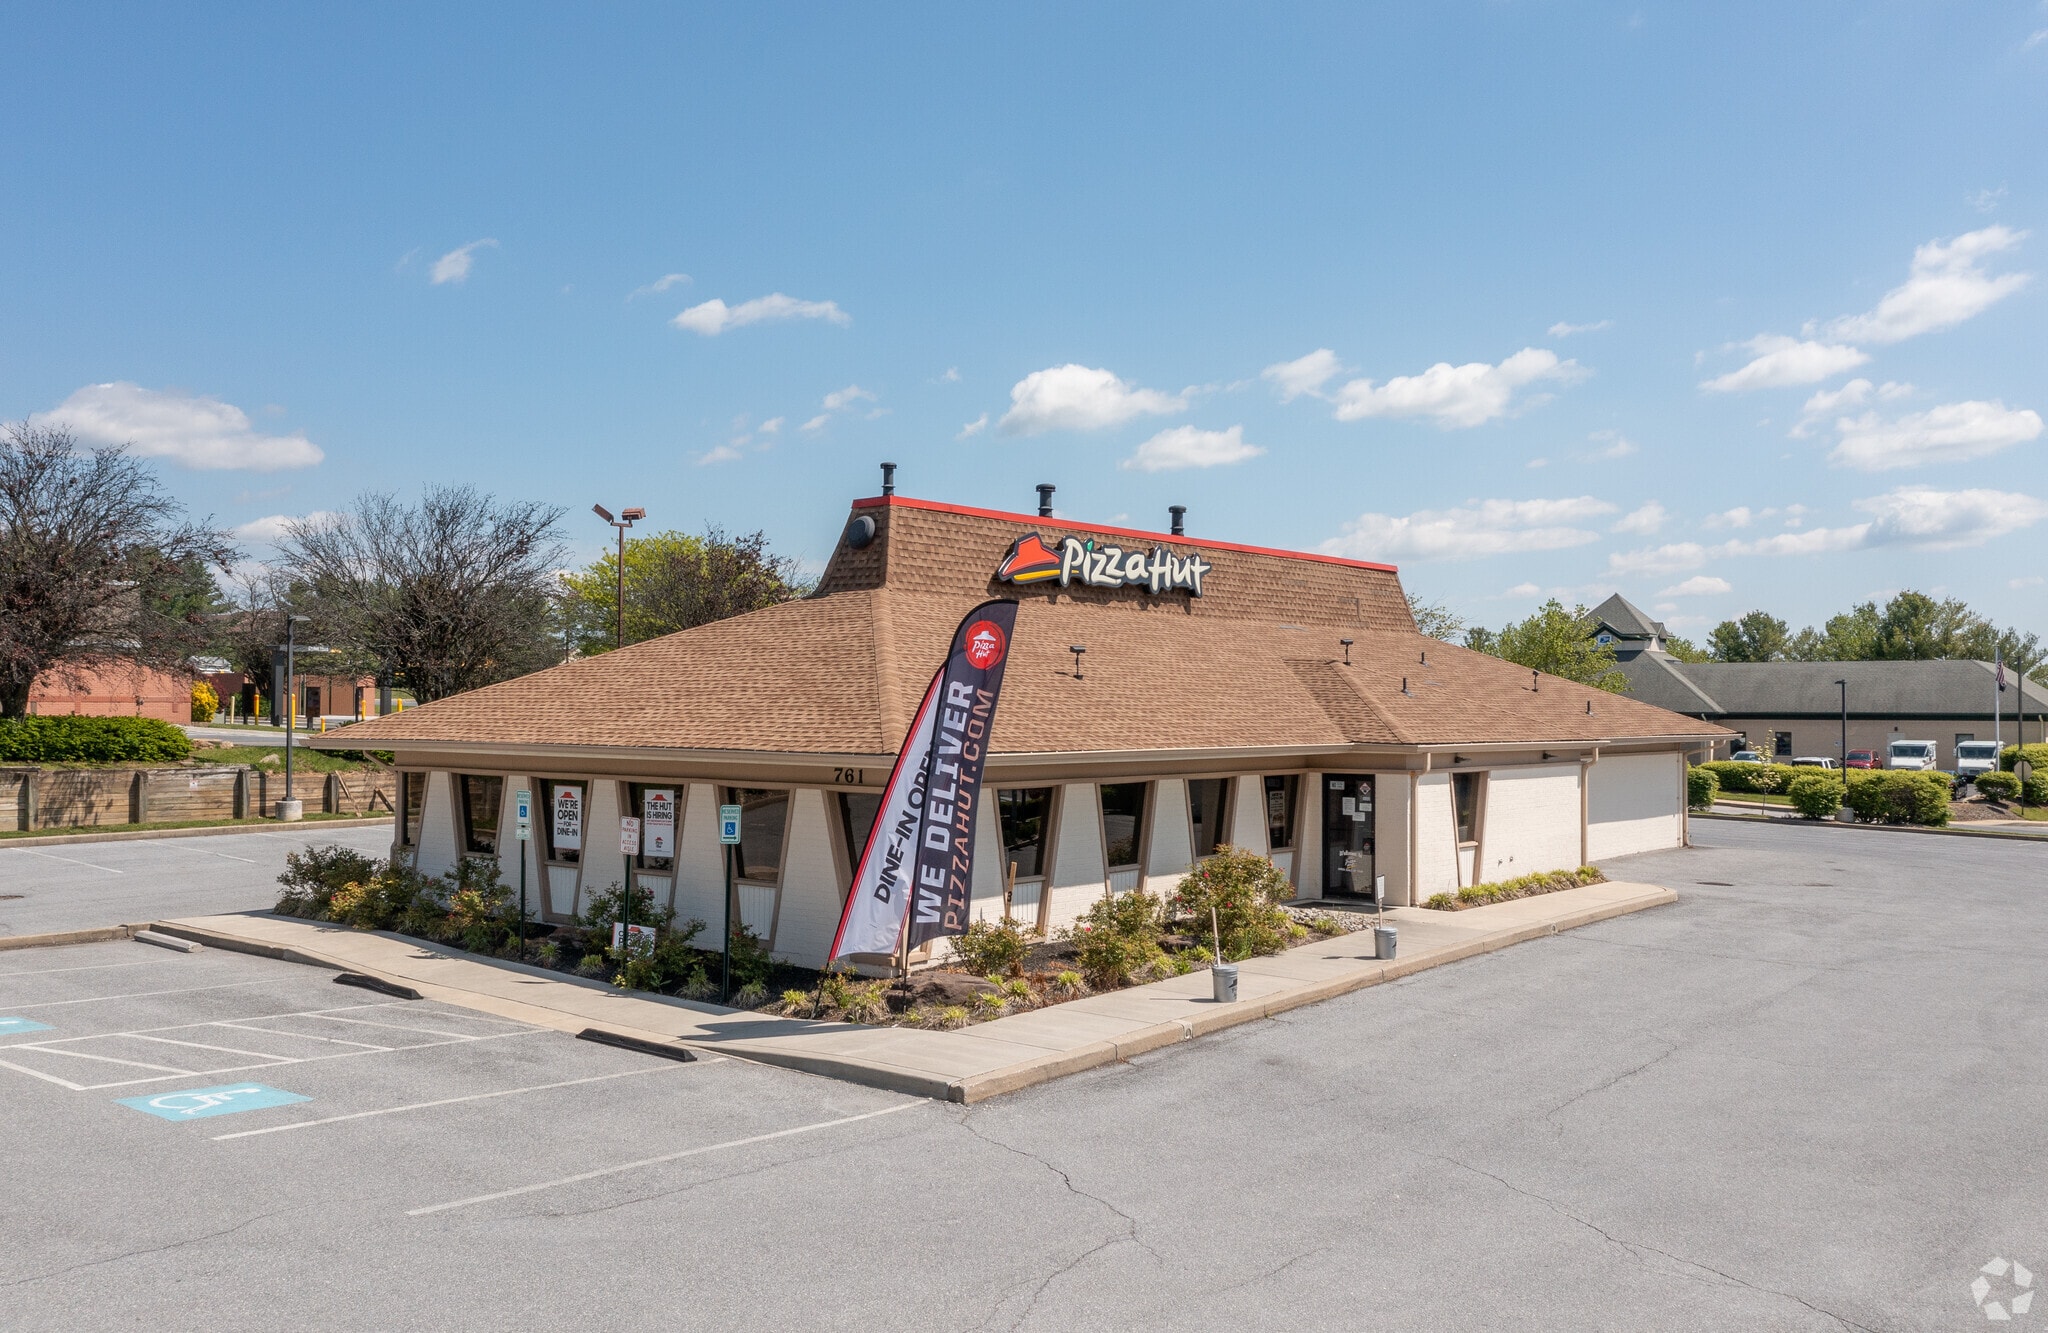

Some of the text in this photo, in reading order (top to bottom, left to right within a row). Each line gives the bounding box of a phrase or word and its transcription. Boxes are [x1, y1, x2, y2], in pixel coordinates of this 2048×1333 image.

[1062, 536, 1211, 597] Pizza Hut
[972, 640, 995, 653] Pizza
[976, 650, 990, 659] Hut
[834, 767, 863, 784] 761
[557, 799, 578, 810] WE'RE
[646, 802, 672, 811] THE HUT
[916, 681, 974, 924] WE DELIVER
[557, 809, 578, 821] OPEN
[646, 811, 672, 820] IS HIRING
[944, 688, 994, 931] PIZZAHUT.COM
[626, 820, 634, 828] NO
[873, 744, 931, 904] DINE-IN OPE
[557, 827, 578, 837] DINE-IN
